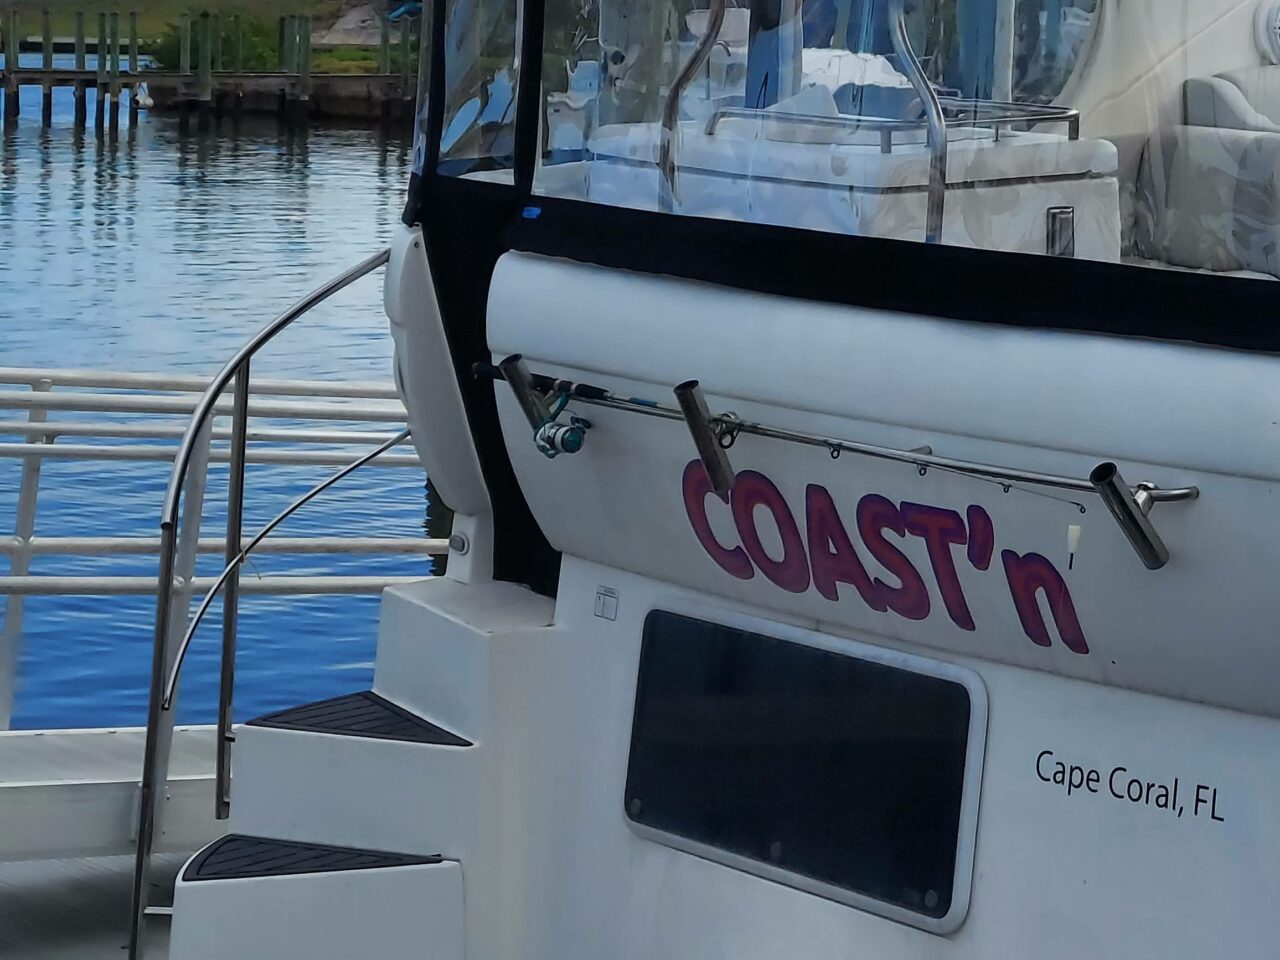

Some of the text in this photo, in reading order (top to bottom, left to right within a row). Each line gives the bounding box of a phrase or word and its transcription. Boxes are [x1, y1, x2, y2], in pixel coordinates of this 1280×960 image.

[1035, 750, 1225, 822] Cape Coral, FL
